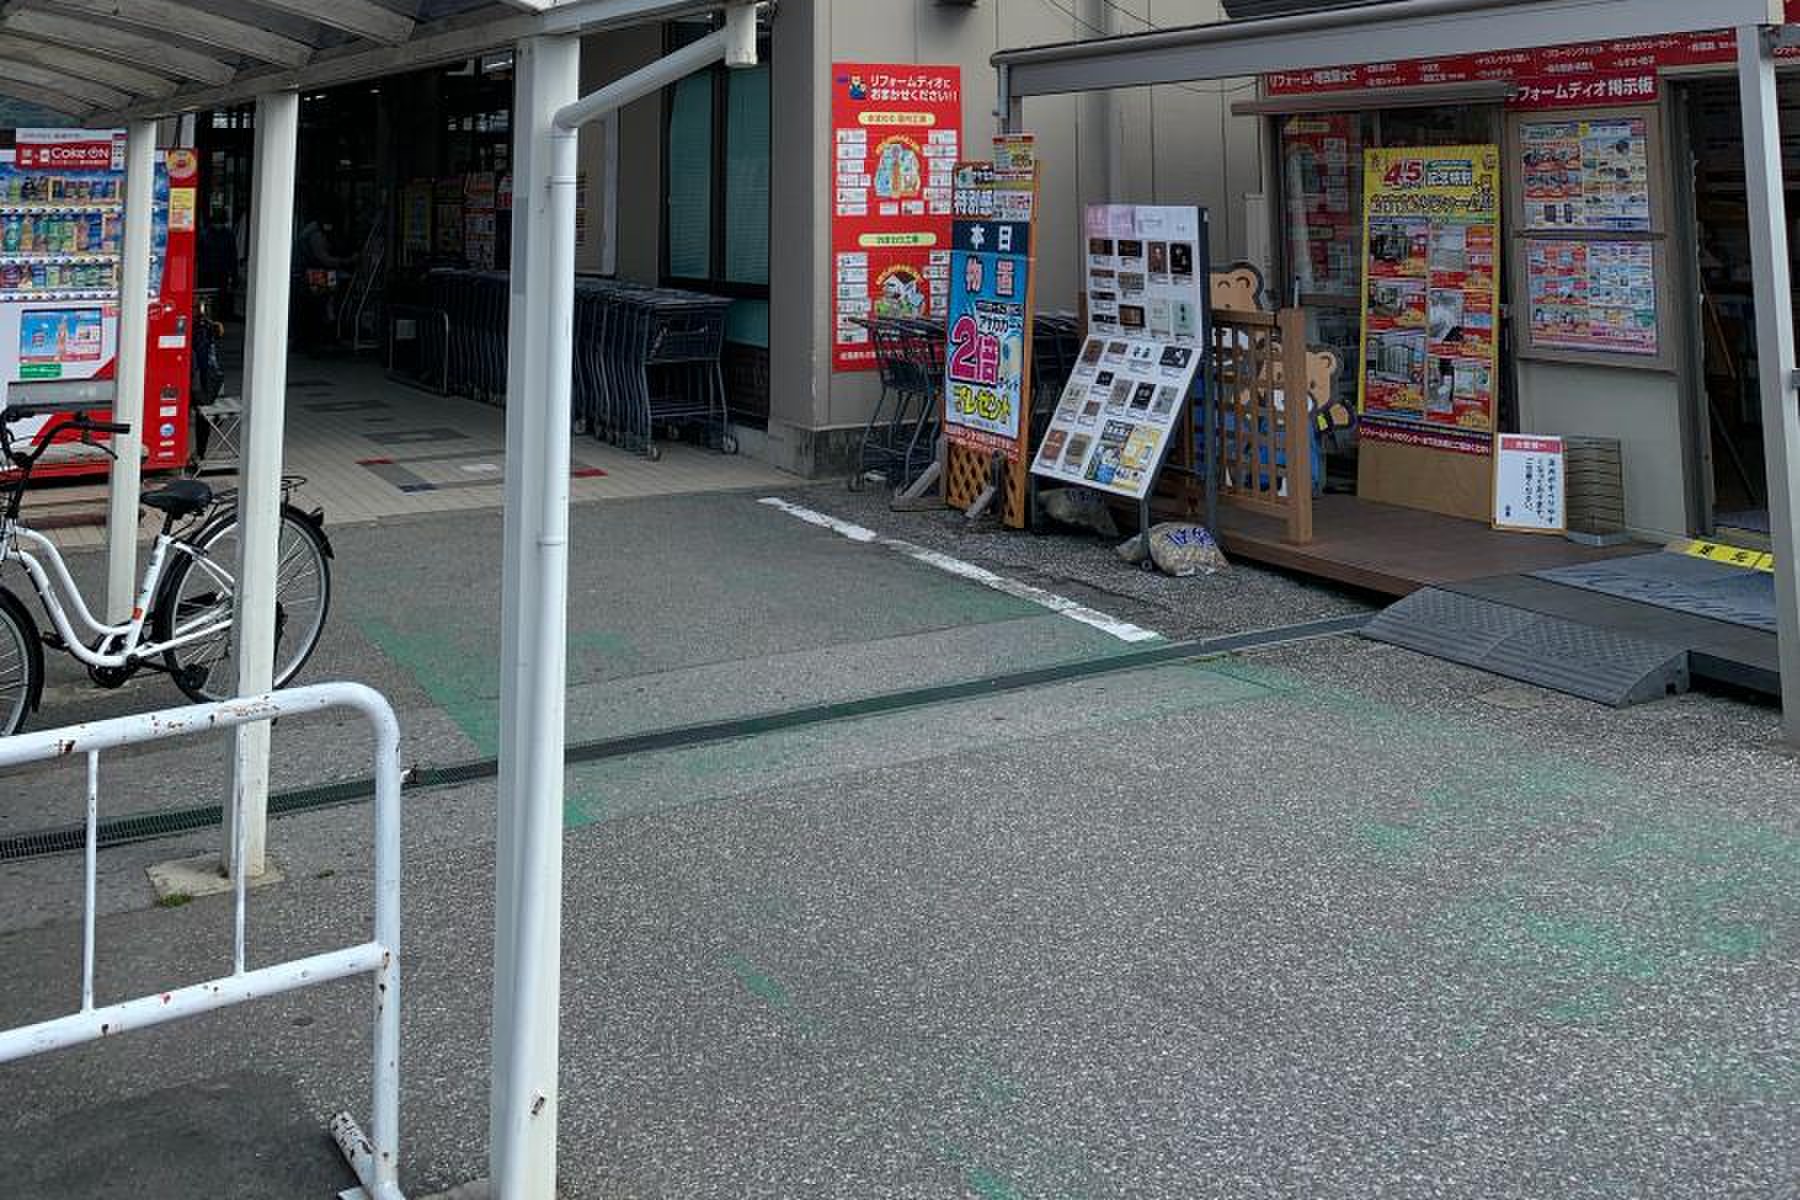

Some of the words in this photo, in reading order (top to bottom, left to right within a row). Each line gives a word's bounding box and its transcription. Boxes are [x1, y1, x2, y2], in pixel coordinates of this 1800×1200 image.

[870, 74, 952, 89] リフォームディオに
[970, 223, 1013, 252] 本日
[950, 315, 999, 387] 2倍
